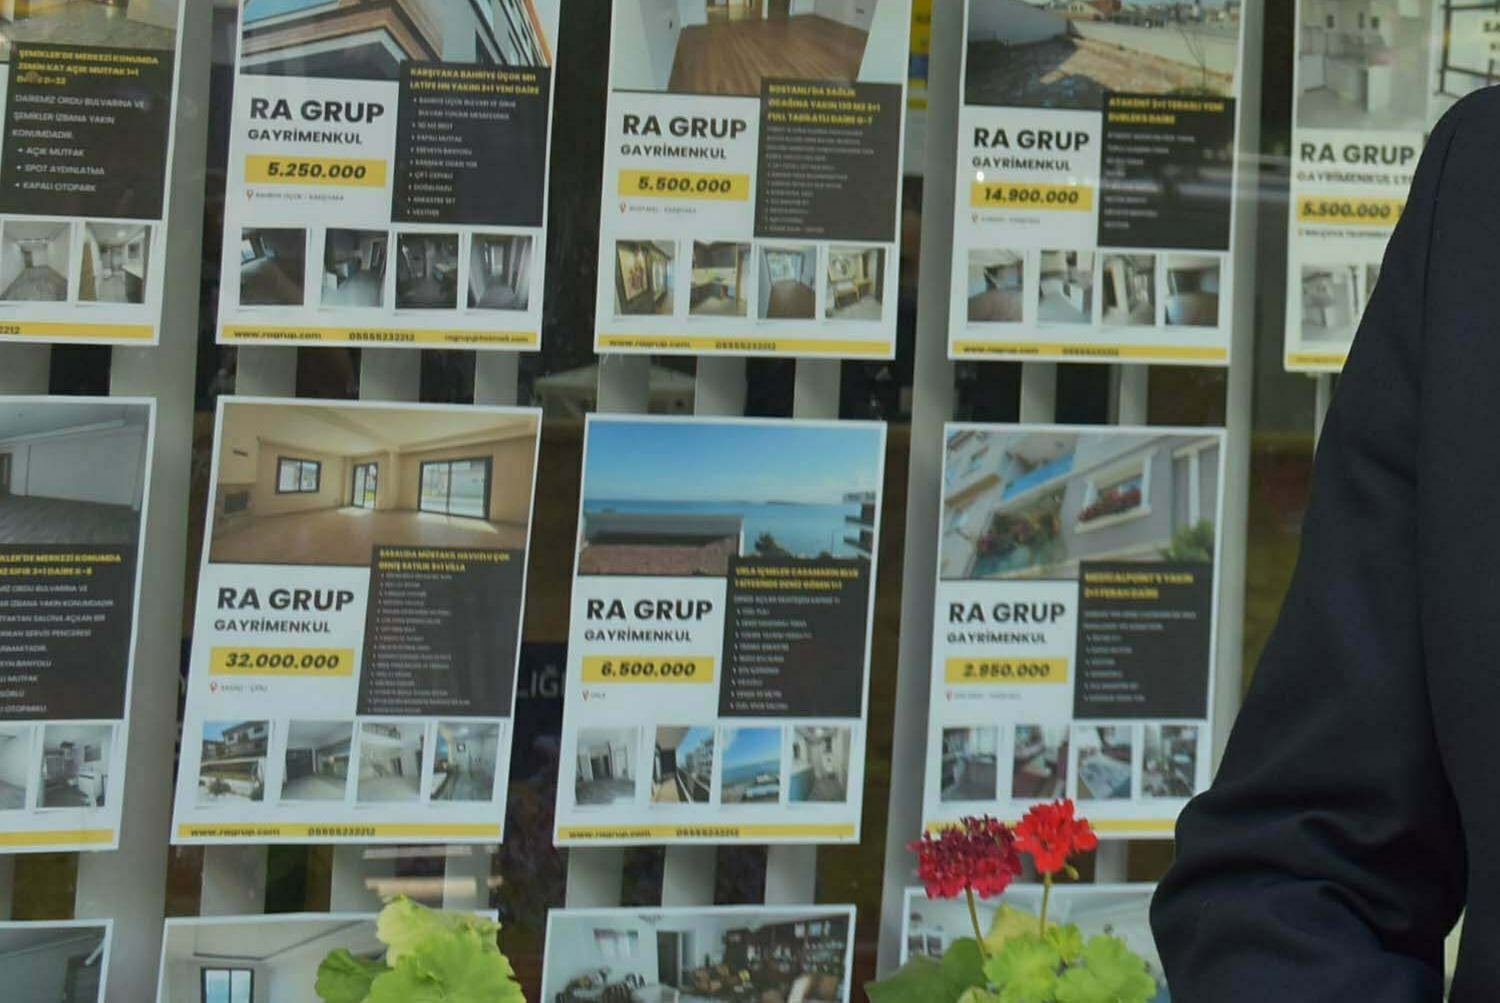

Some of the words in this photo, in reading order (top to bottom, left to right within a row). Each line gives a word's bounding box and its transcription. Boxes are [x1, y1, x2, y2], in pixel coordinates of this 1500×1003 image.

[250, 97, 292, 121] RA
[300, 101, 385, 125] GRUP
[623, 114, 661, 136] RA
[669, 118, 747, 140] GRUP
[248, 127, 362, 146] GAYRİMENKUL
[974, 128, 1010, 148] RA
[1016, 130, 1090, 152] GRUP
[620, 143, 726, 160] GAYRİMENKUL
[1300, 143, 1335, 162] RA
[1344, 144, 1415, 165] GRUP
[268, 161, 366, 180] 5.250.000
[972, 154, 1072, 172] GAYRİMENKUL
[638, 176, 732, 194] 5.500.000
[984, 186, 1079, 204] 14.900.000
[1303, 201, 1390, 218] 5.500.000
[218, 586, 258, 610] RA
[268, 588, 354, 612] GRUP
[588, 598, 627, 620] RA
[634, 598, 712, 620] GRUP
[948, 603, 984, 624] RA
[992, 604, 1066, 624] GRUP
[214, 617, 332, 634] GAYRİMENKUL
[584, 626, 692, 642] GAYRİMENKUL
[946, 631, 1047, 645] GAYRİMENKUL
[225, 652, 340, 669] 32.000.000
[602, 661, 696, 677] 6.500.000
